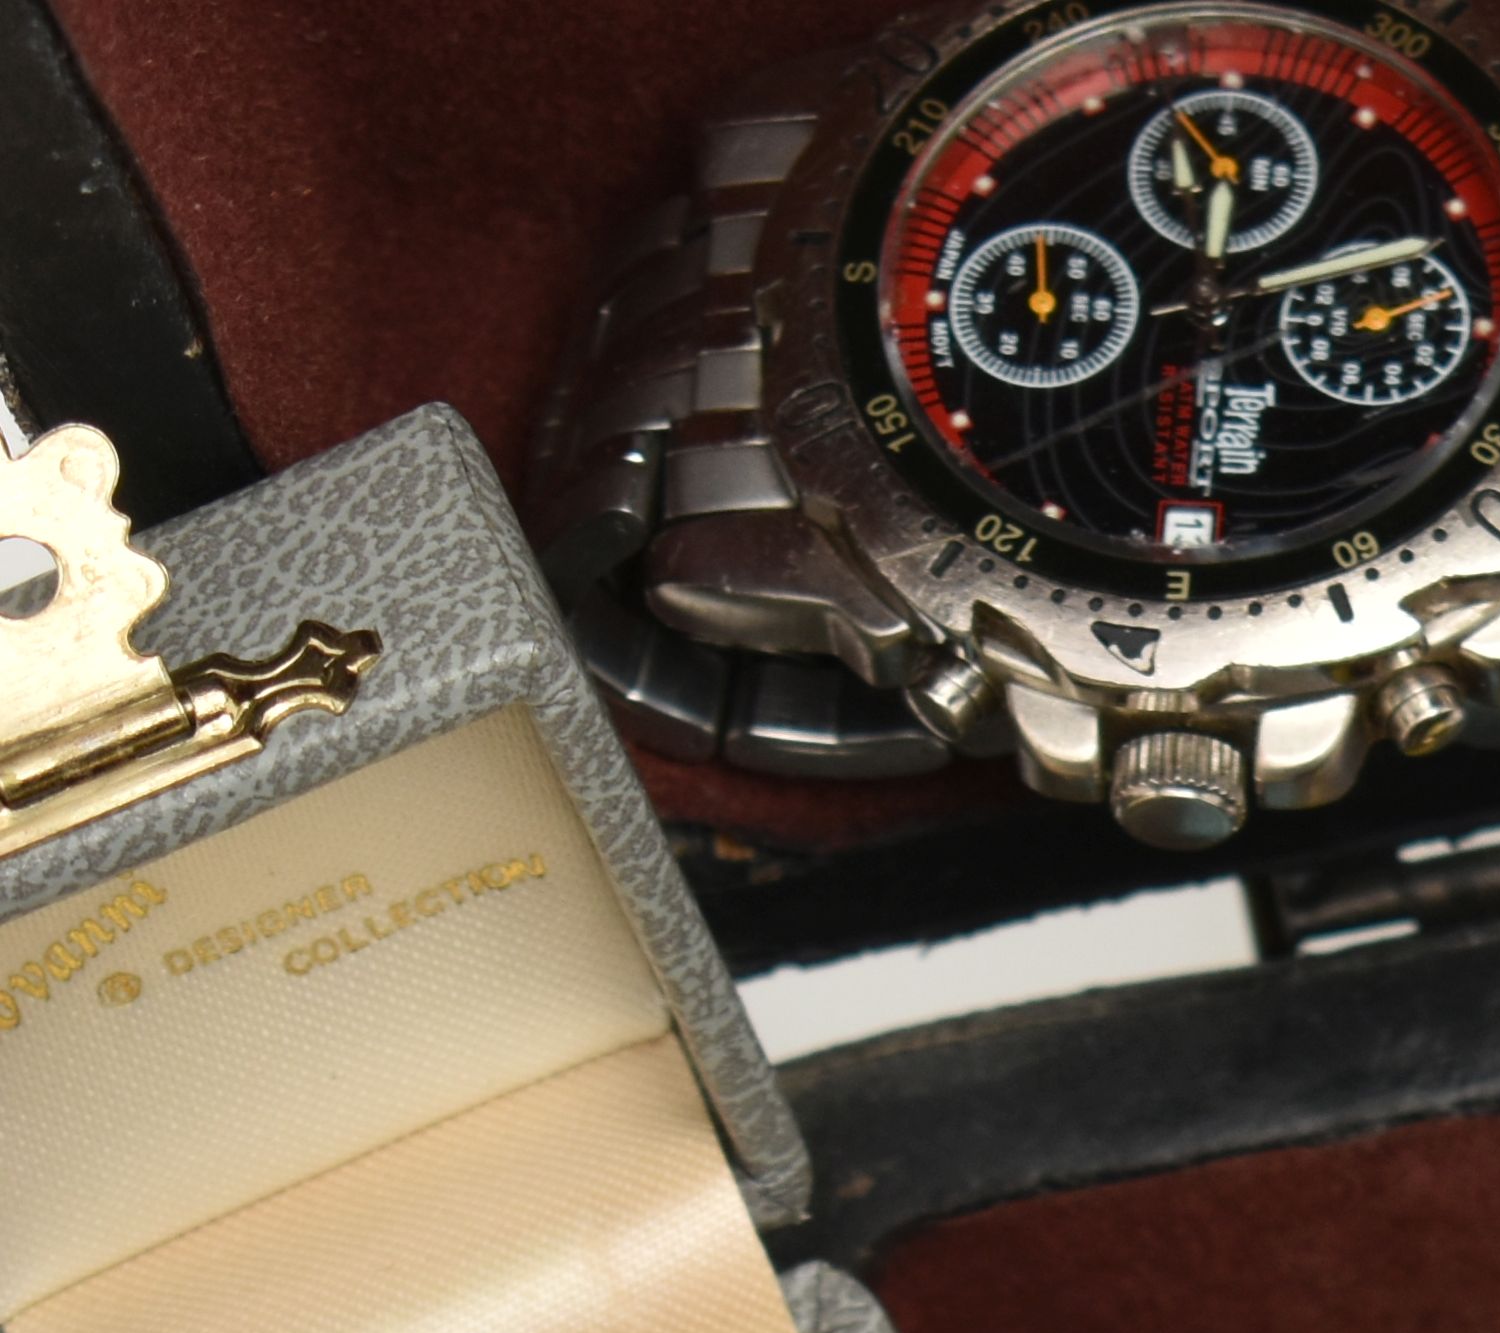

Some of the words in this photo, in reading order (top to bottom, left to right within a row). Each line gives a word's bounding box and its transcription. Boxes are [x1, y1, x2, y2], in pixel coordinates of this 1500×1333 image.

[1364, 11, 1432, 59] 300
[894, 98, 948, 156] 210
[1250, 157, 1271, 193] MIN
[1271, 162, 1291, 189] 60
[843, 261, 876, 283] S
[935, 228, 966, 281] JAPAN
[1007, 253, 1026, 277] 40
[1070, 293, 1090, 323] SEC
[1093, 299, 1112, 323] 60
[1407, 312, 1424, 342] SEC
[865, 393, 915, 453] 150
[1216, 381, 1276, 476] Terrain
[975, 515, 1039, 562] 120
[1332, 531, 1380, 569] 60
[1165, 570, 1190, 599] E
[162, 873, 374, 978] DESIGNER
[283, 852, 547, 977] COLLECTION
[0, 872, 168, 1030] ovanni
